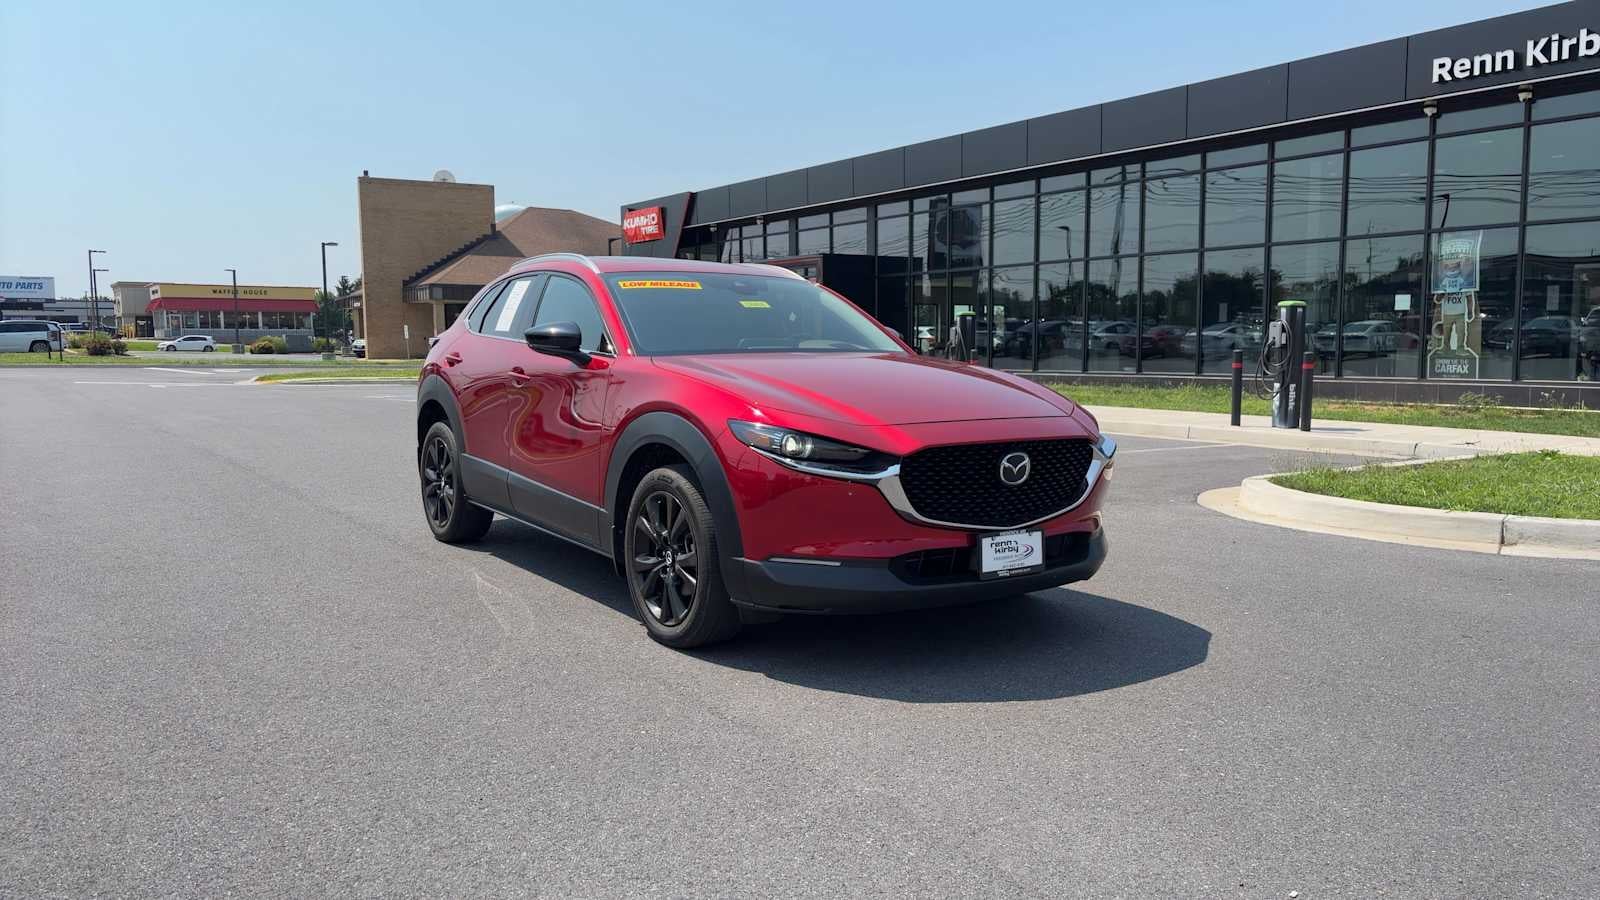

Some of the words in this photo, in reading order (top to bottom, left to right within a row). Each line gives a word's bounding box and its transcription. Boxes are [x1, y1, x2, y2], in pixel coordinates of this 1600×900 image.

[1432, 49, 1515, 83] Renn
[624, 213, 658, 229] KUMHO
[0, 281, 13, 289] TO
[15, 281, 43, 290] PARTS
[1447, 296, 1462, 304] FOX
[1434, 364, 1469, 374] CARFAX
